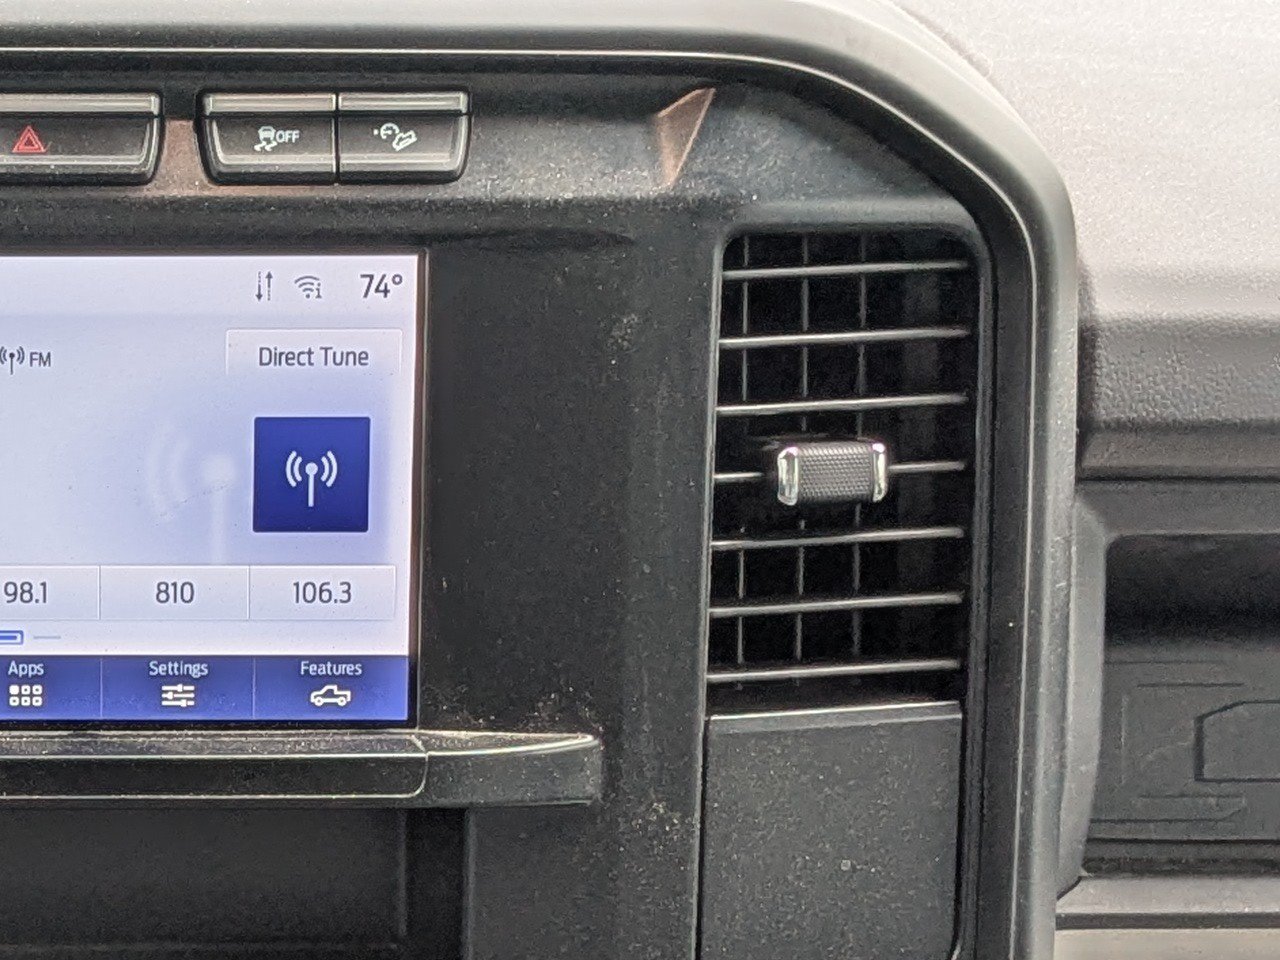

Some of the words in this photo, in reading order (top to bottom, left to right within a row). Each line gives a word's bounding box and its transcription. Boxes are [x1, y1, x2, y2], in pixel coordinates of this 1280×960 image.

[275, 129, 300, 144] OFF
[360, 274, 403, 298] 74°
[29, 352, 52, 367] FM
[258, 346, 313, 368] Direct
[318, 346, 369, 368] Tune
[3, 582, 48, 604] 98.1
[154, 582, 195, 604] 810
[292, 582, 352, 604] 106.3
[8, 660, 44, 681] Apps
[148, 660, 209, 681] Settings
[299, 660, 363, 677] Features
